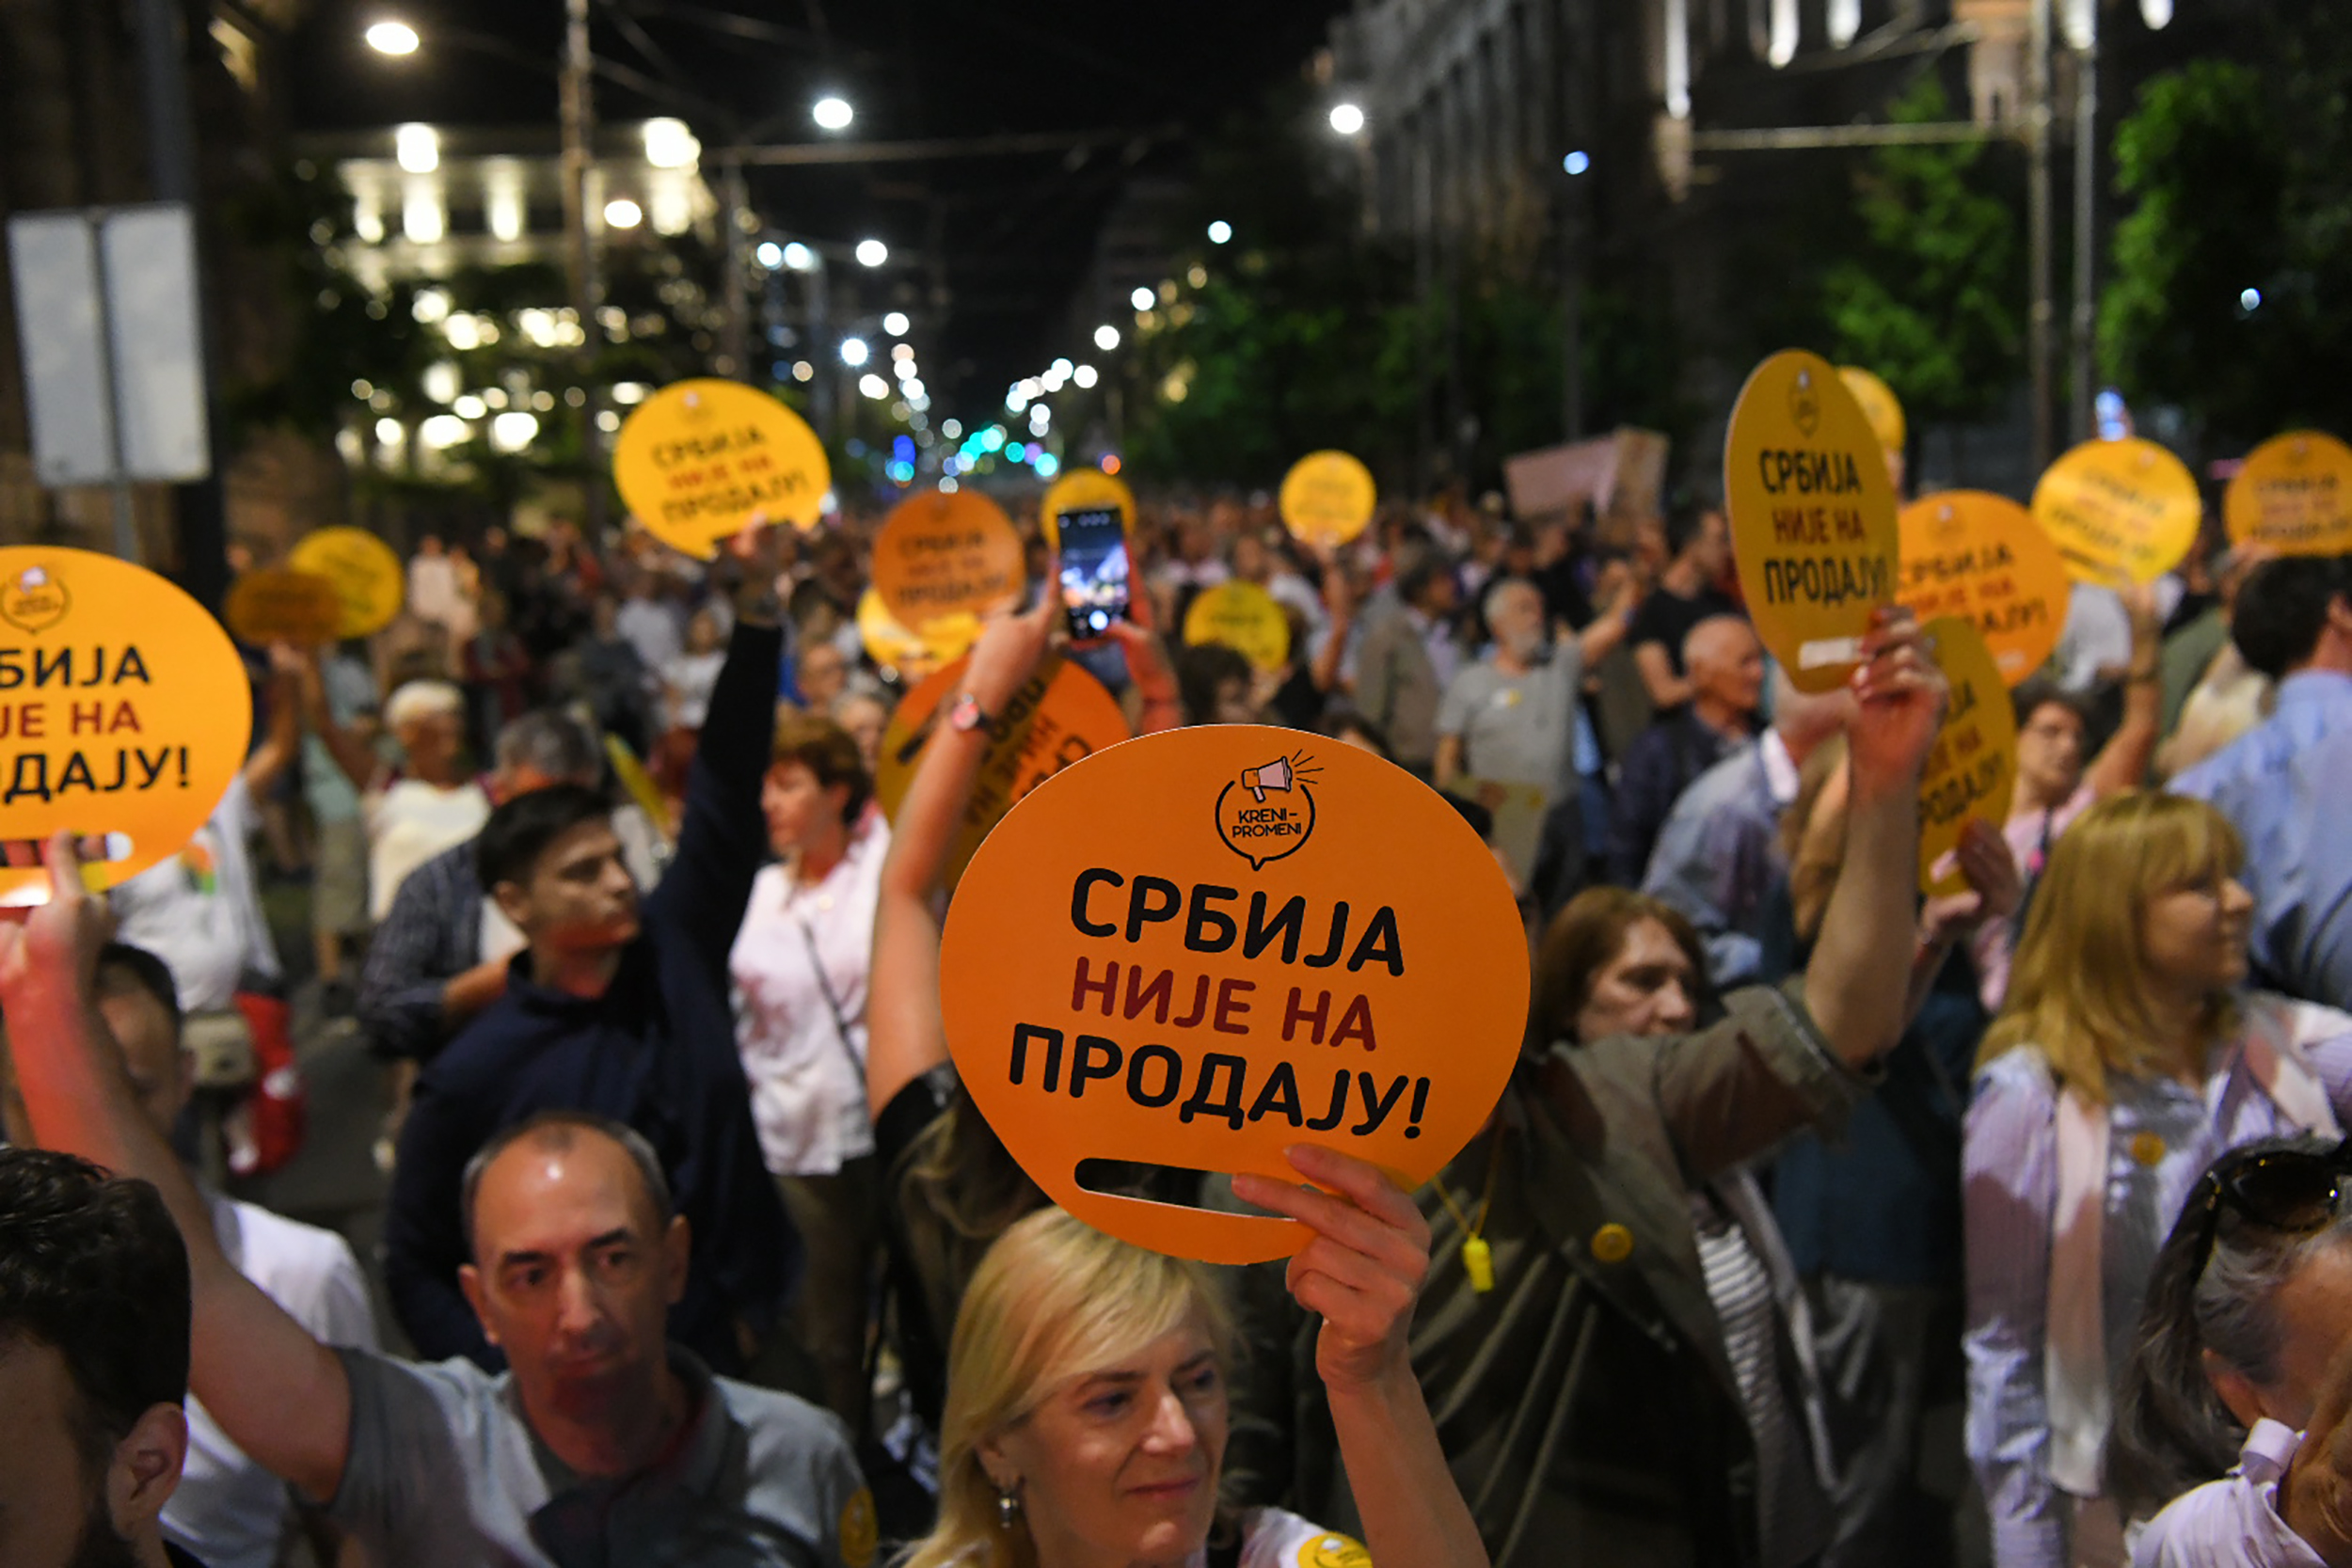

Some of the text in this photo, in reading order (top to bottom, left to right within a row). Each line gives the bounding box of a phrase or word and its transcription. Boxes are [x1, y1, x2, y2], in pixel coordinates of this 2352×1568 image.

[1760, 449, 1864, 496] СРБИЈА
[1772, 507, 1867, 545] НИЈЕ НА
[1764, 555, 1887, 608] ПРОДАЈУ!
[71, 700, 142, 736] НА
[0, 745, 192, 804] ДАЈУ!
[1232, 822, 1302, 838] PROMENI
[1237, 807, 1298, 824] KRENI-
[1070, 867, 1405, 976] СРБИЈА
[1071, 956, 1377, 1052] НИЈЕ НА
[1008, 1022, 1431, 1140] ПРОДАЈУ!
